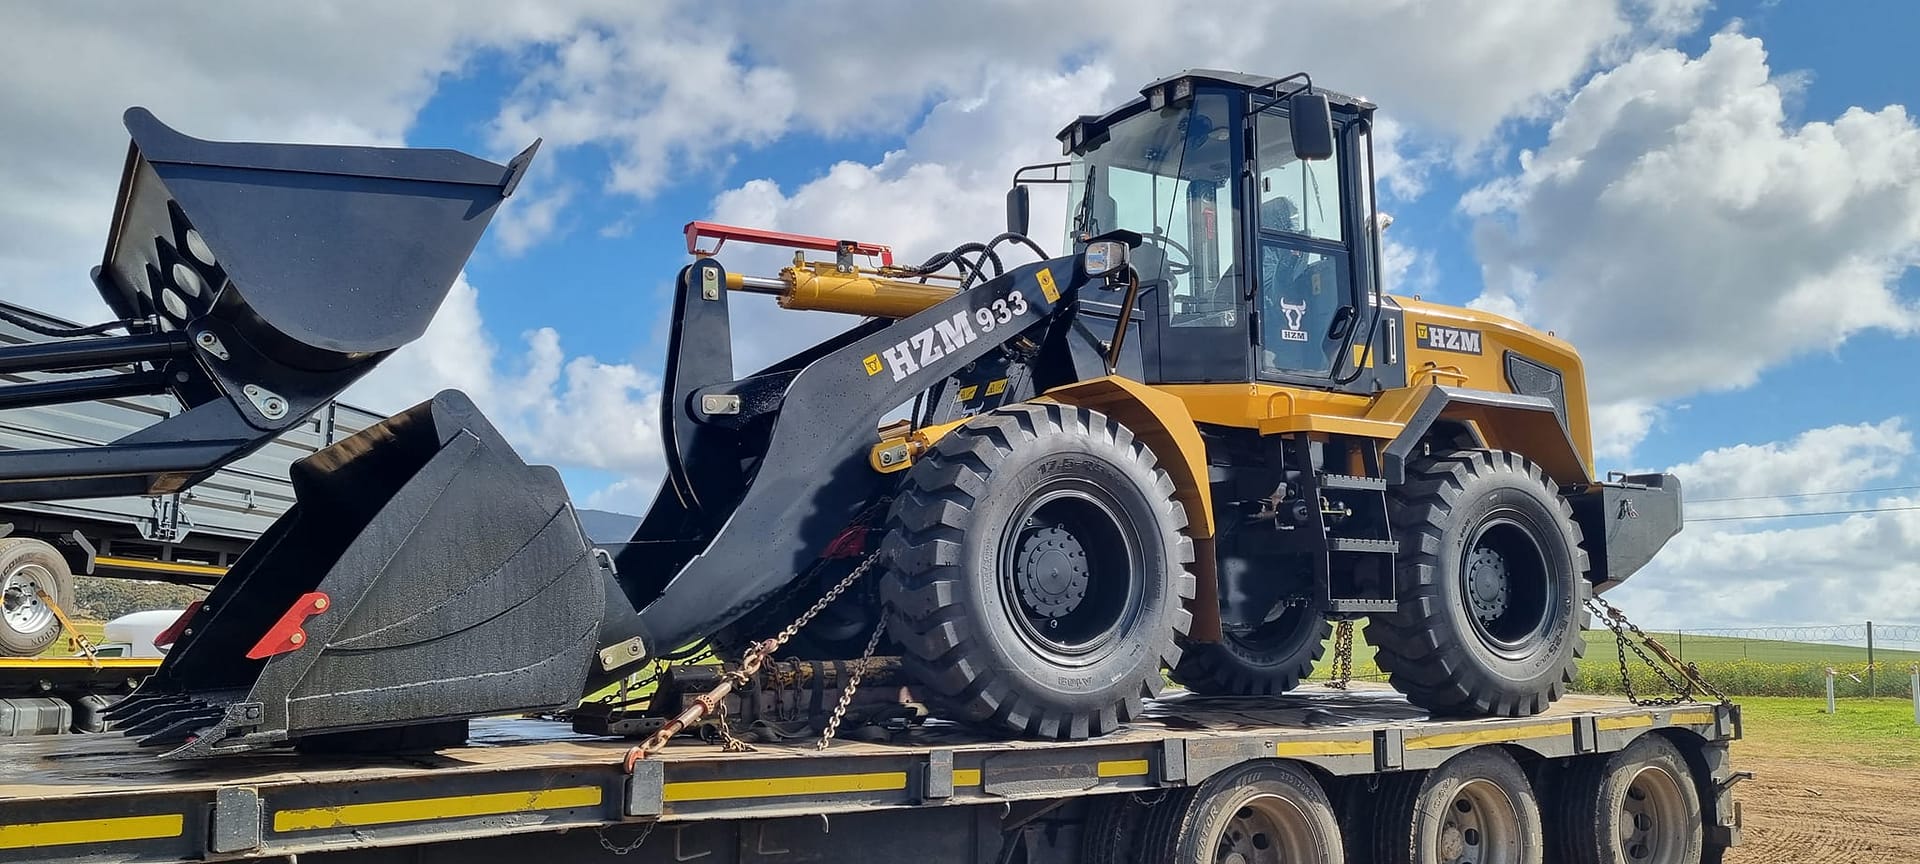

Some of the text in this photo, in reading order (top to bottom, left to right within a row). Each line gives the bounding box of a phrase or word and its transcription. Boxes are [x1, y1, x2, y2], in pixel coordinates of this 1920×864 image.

[882, 290, 1028, 382] HZM 933
[1284, 331, 1305, 339] HZM
[1429, 327, 1480, 352] HZM
[1194, 805, 1219, 864] GATOR
